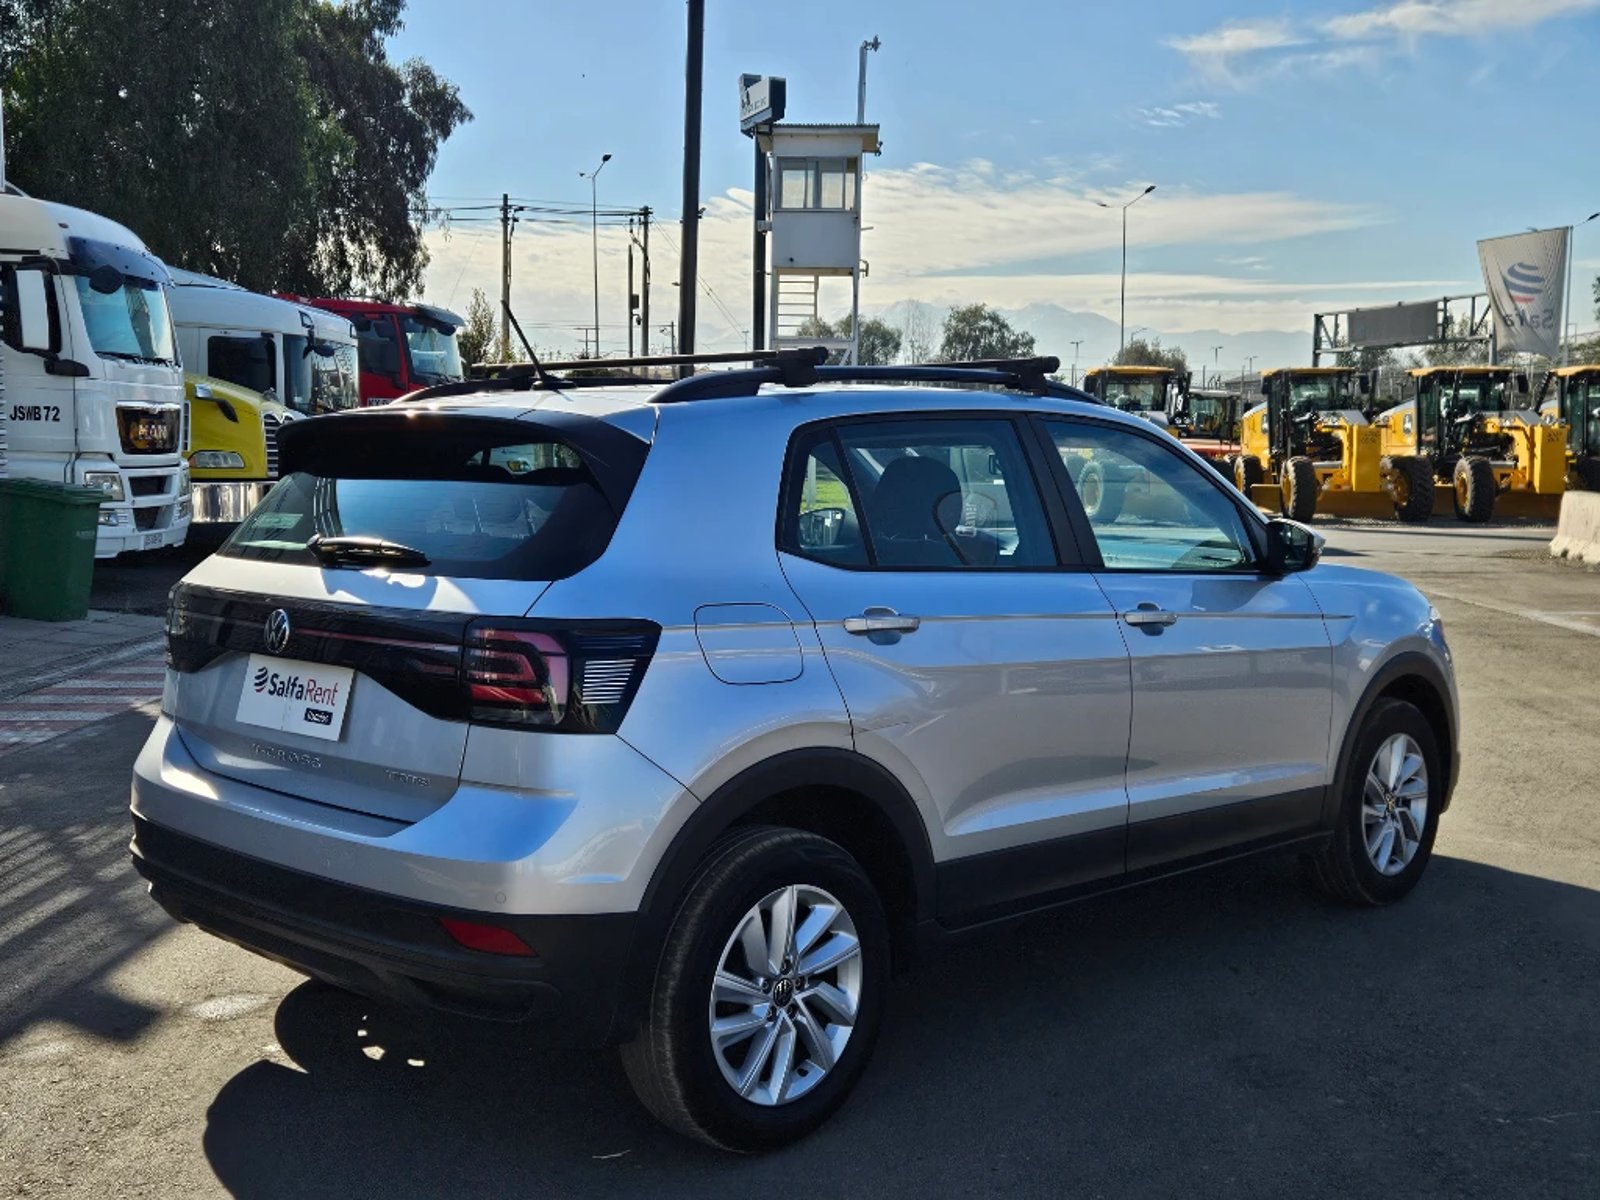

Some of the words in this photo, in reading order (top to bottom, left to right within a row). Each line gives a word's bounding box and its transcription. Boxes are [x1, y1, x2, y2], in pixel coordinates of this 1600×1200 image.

[9, 405, 42, 421] JSWB
[43, 405, 61, 422] 72
[138, 424, 168, 440] MAN
[268, 673, 338, 707] SalfaRent
